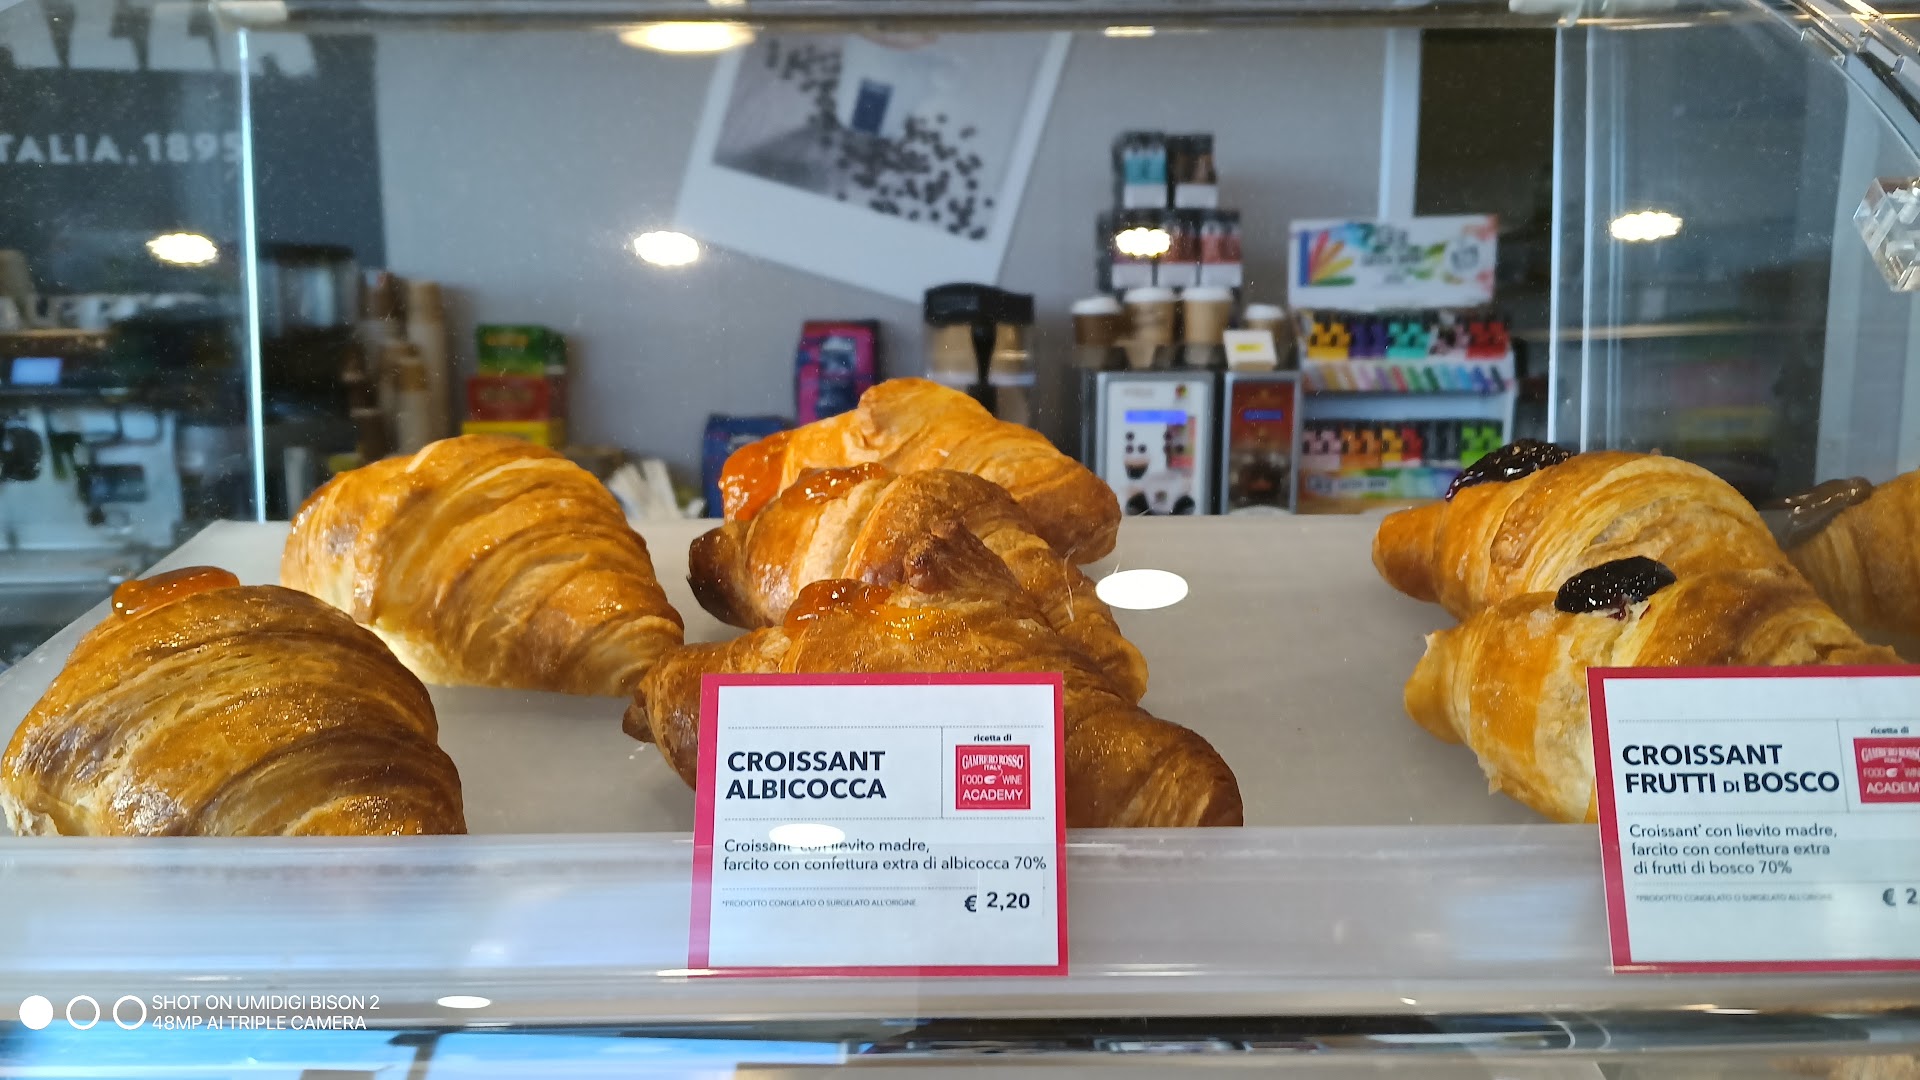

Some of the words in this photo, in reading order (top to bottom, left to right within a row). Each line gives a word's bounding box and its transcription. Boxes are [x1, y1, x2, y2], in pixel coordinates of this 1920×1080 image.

[973, 733, 1001, 742] ricetta
[1003, 733, 1012, 742] di
[1900, 726, 1909, 734] di
[727, 750, 886, 772] CROISSANT
[998, 754, 1024, 770] ROSSO
[1622, 744, 1783, 765] CROISSANT
[983, 764, 1002, 772] ITALY
[961, 774, 984, 785] FOOD
[1002, 774, 1023, 785] WINE
[1625, 772, 1716, 793] FRUTTI
[1723, 780, 1740, 793] DI
[1743, 771, 1840, 793] BOSCO
[725, 778, 887, 799] ALBICOCCA
[962, 788, 1024, 801] ACADEMY
[1867, 781, 1920, 794] ACADEM
[1705, 826, 1732, 838] con
[1736, 823, 1781, 838] lievito
[1785, 823, 1838, 839] madre,
[879, 838, 930, 853] madre,
[1631, 842, 1678, 856] farcito
[1682, 845, 1710, 856] con
[1714, 842, 1790, 856] confettura
[1793, 843, 1831, 856] extra
[723, 856, 769, 870] farcito
[773, 860, 800, 870] con
[804, 856, 878, 870] confettura
[882, 858, 918, 870] extra
[923, 856, 937, 870] di
[941, 856, 1010, 870] albicocca
[1014, 856, 1047, 870] 70%
[1633, 860, 1648, 875] di
[1652, 860, 1687, 875] frutti
[1691, 860, 1705, 875] di
[1709, 860, 1755, 875] bosco
[1758, 860, 1793, 875] 70%
[964, 894, 978, 912] €
[986, 891, 1031, 911] 2,20
